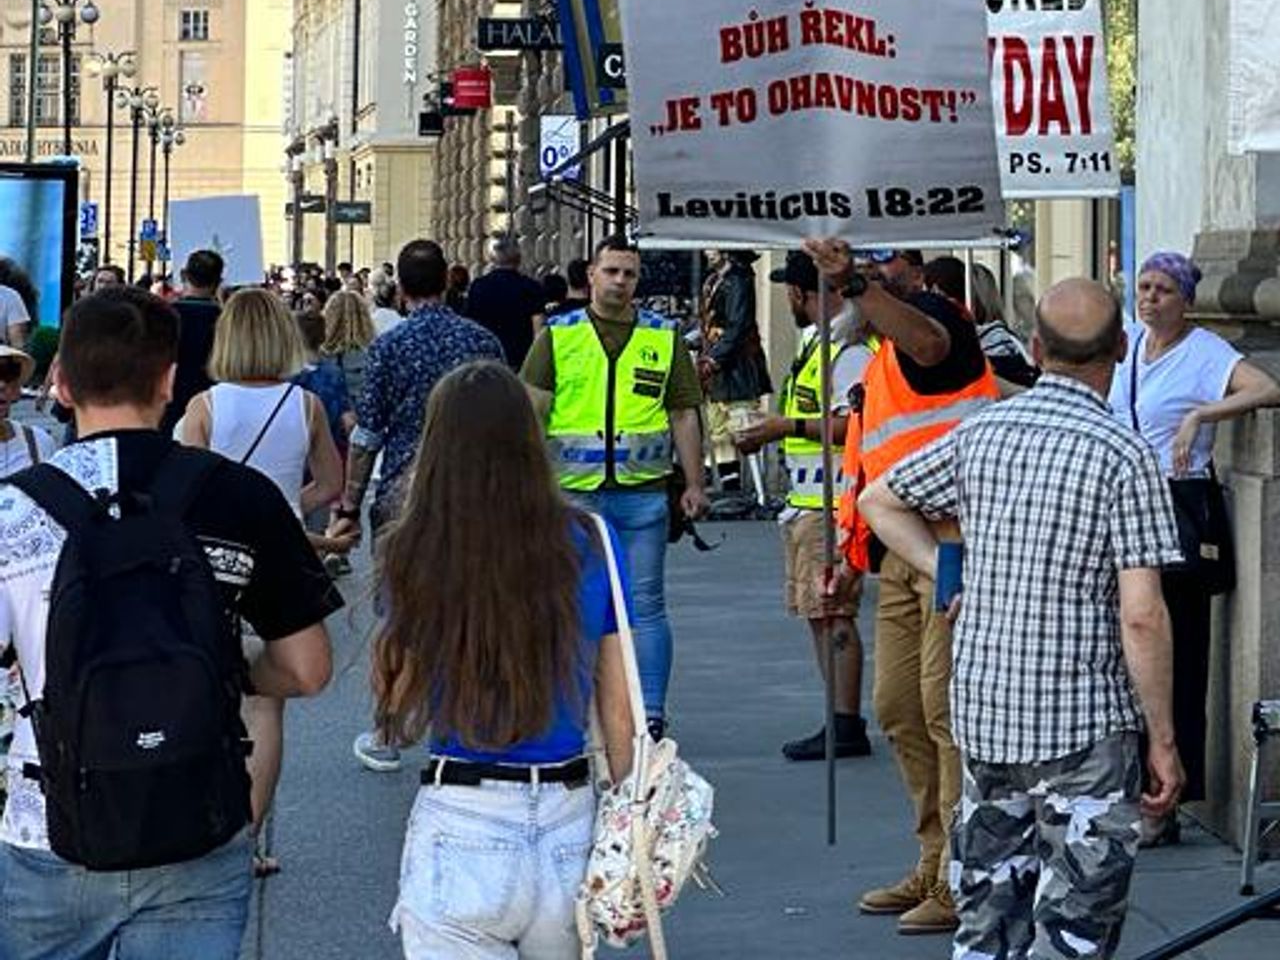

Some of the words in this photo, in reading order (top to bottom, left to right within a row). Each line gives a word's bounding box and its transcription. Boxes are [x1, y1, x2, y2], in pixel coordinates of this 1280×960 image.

[719, 9, 791, 64] BŮH
[799, 0, 896, 58] ŘEKL:
[649, 96, 703, 137] „JE
[709, 87, 758, 127] TO
[767, 72, 977, 124] OHAVNOST!”
[1009, 151, 1052, 174] PS.
[1064, 151, 1112, 174] 7:11
[656, 190, 853, 222] Leviticus
[865, 185, 987, 219] 18:22
